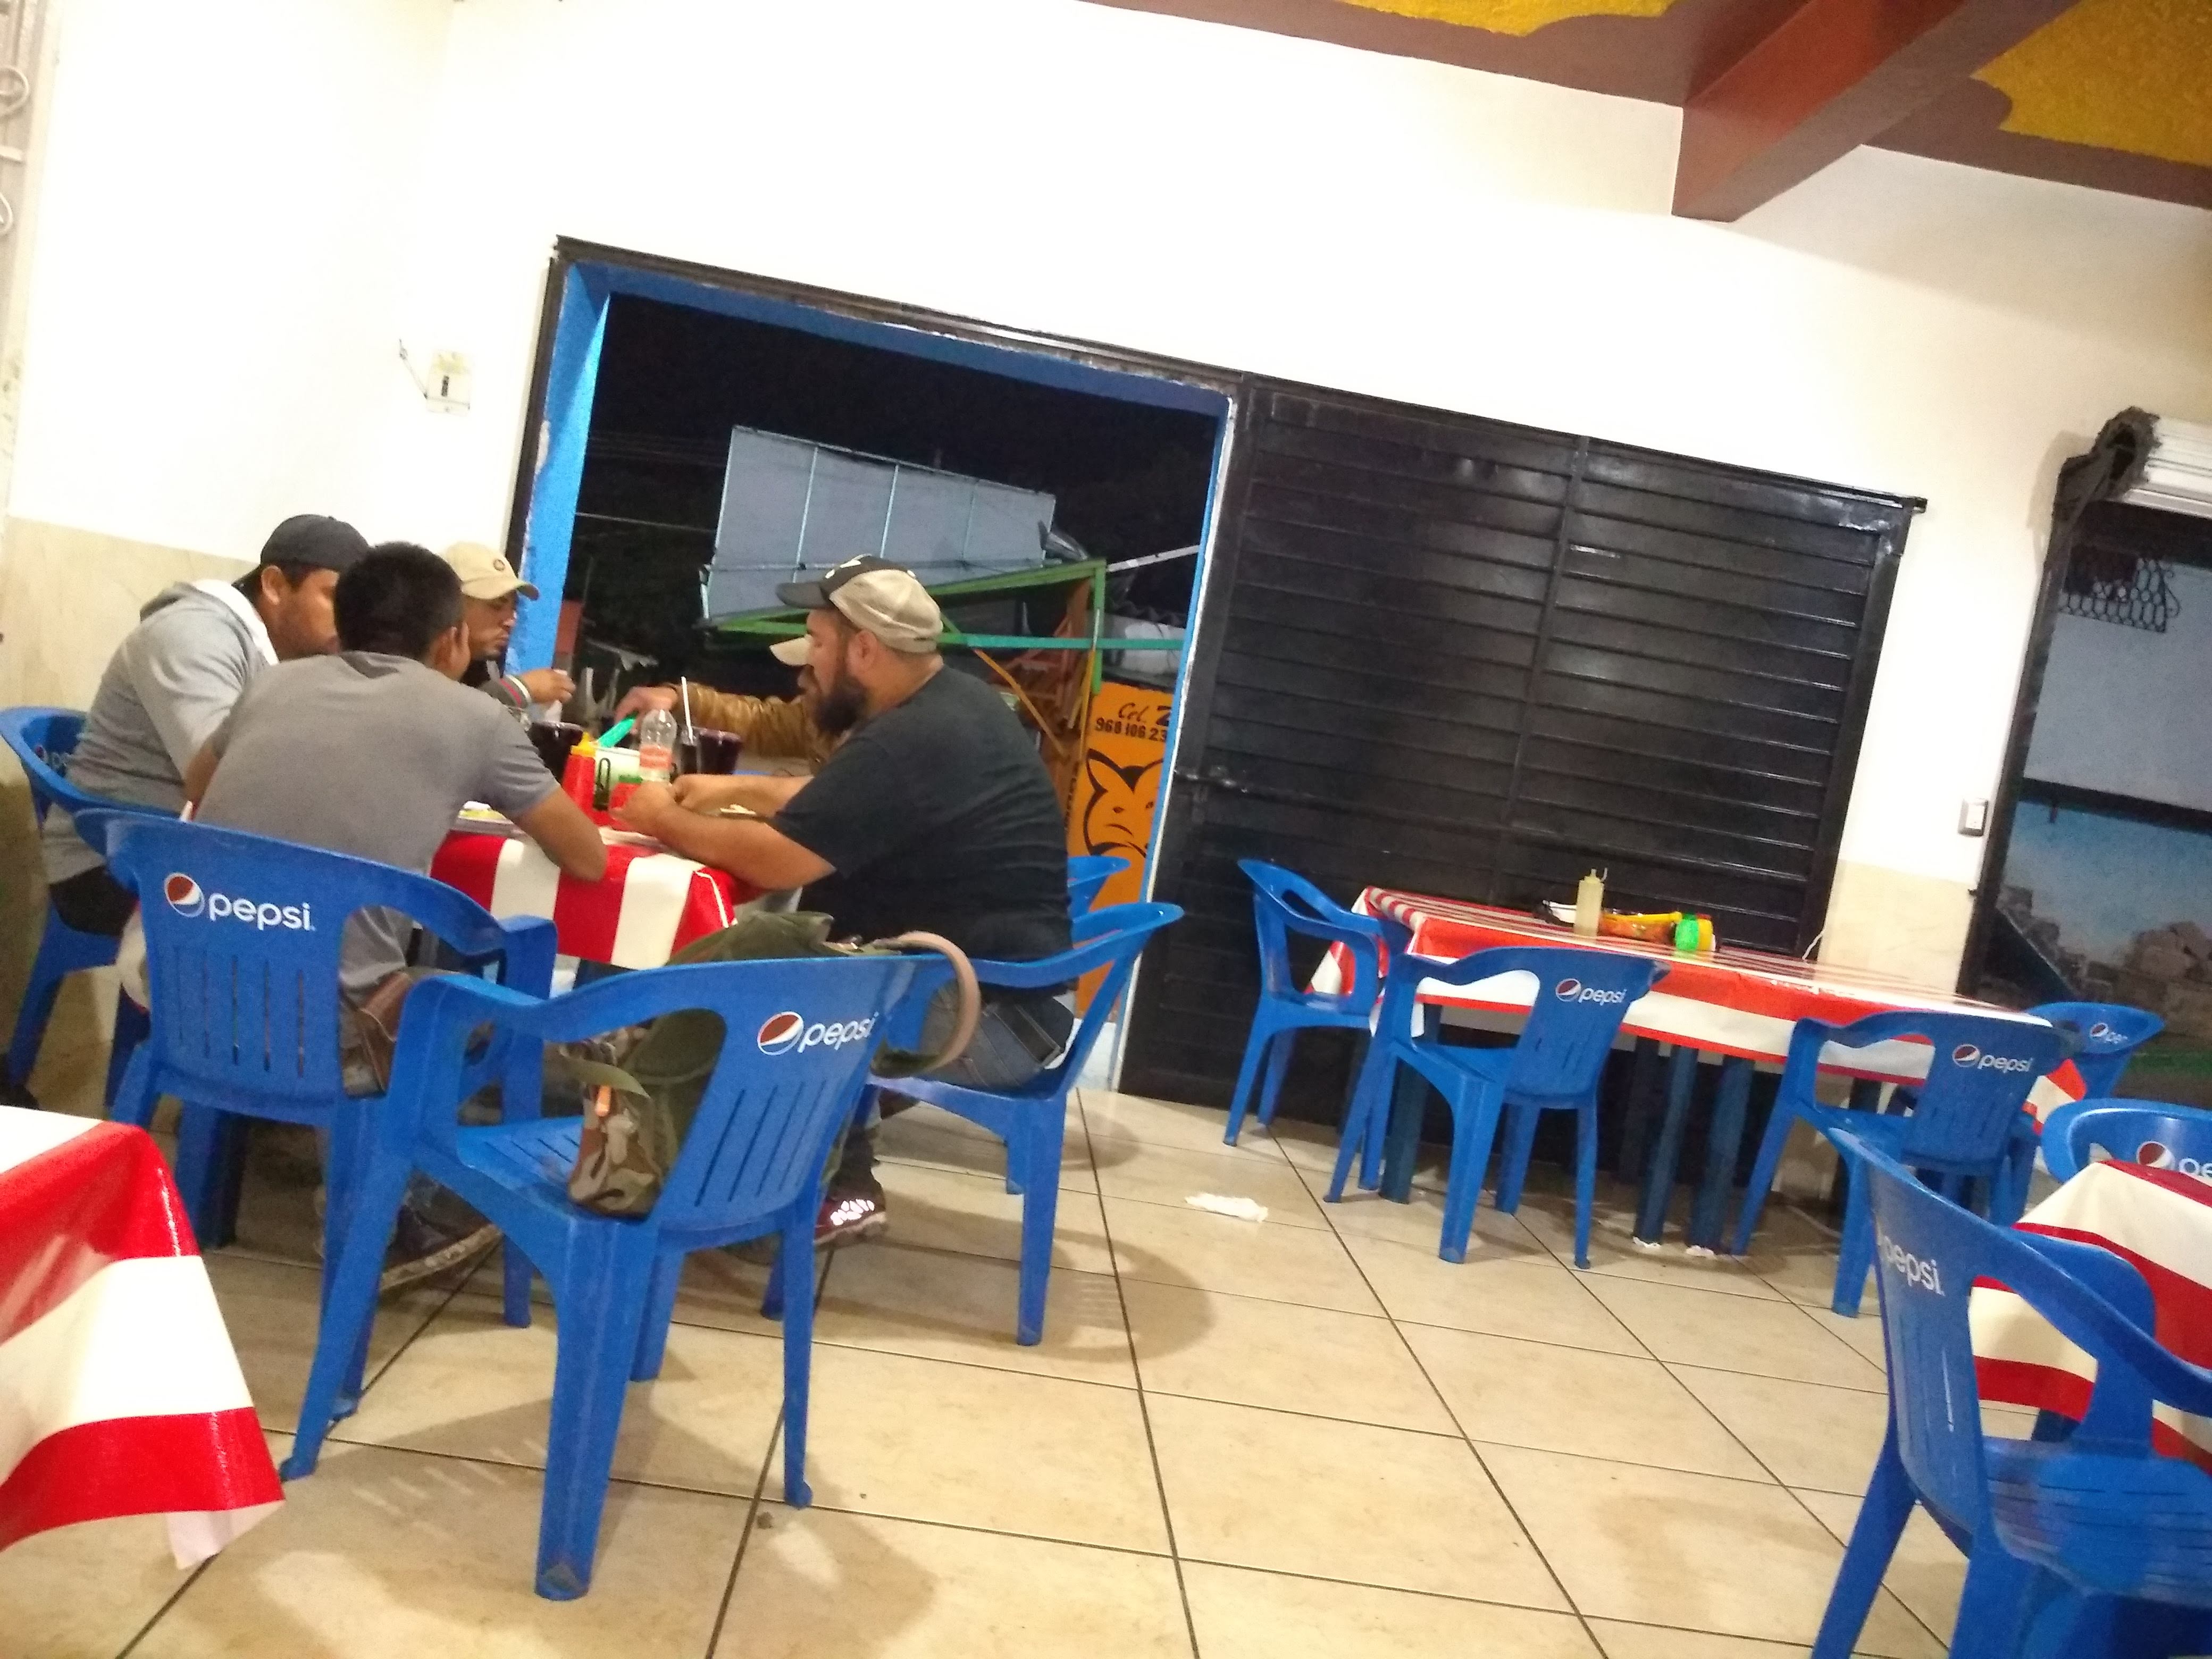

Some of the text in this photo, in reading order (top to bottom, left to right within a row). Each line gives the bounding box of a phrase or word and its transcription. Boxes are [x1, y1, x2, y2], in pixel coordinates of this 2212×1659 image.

[208, 893, 312, 931] pepsi
[1578, 987, 1627, 1006] pepsi
[797, 1011, 879, 1053] pepsi
[1976, 1054, 2034, 1074] pepsi
[1880, 1235, 1942, 1294] pepsi
